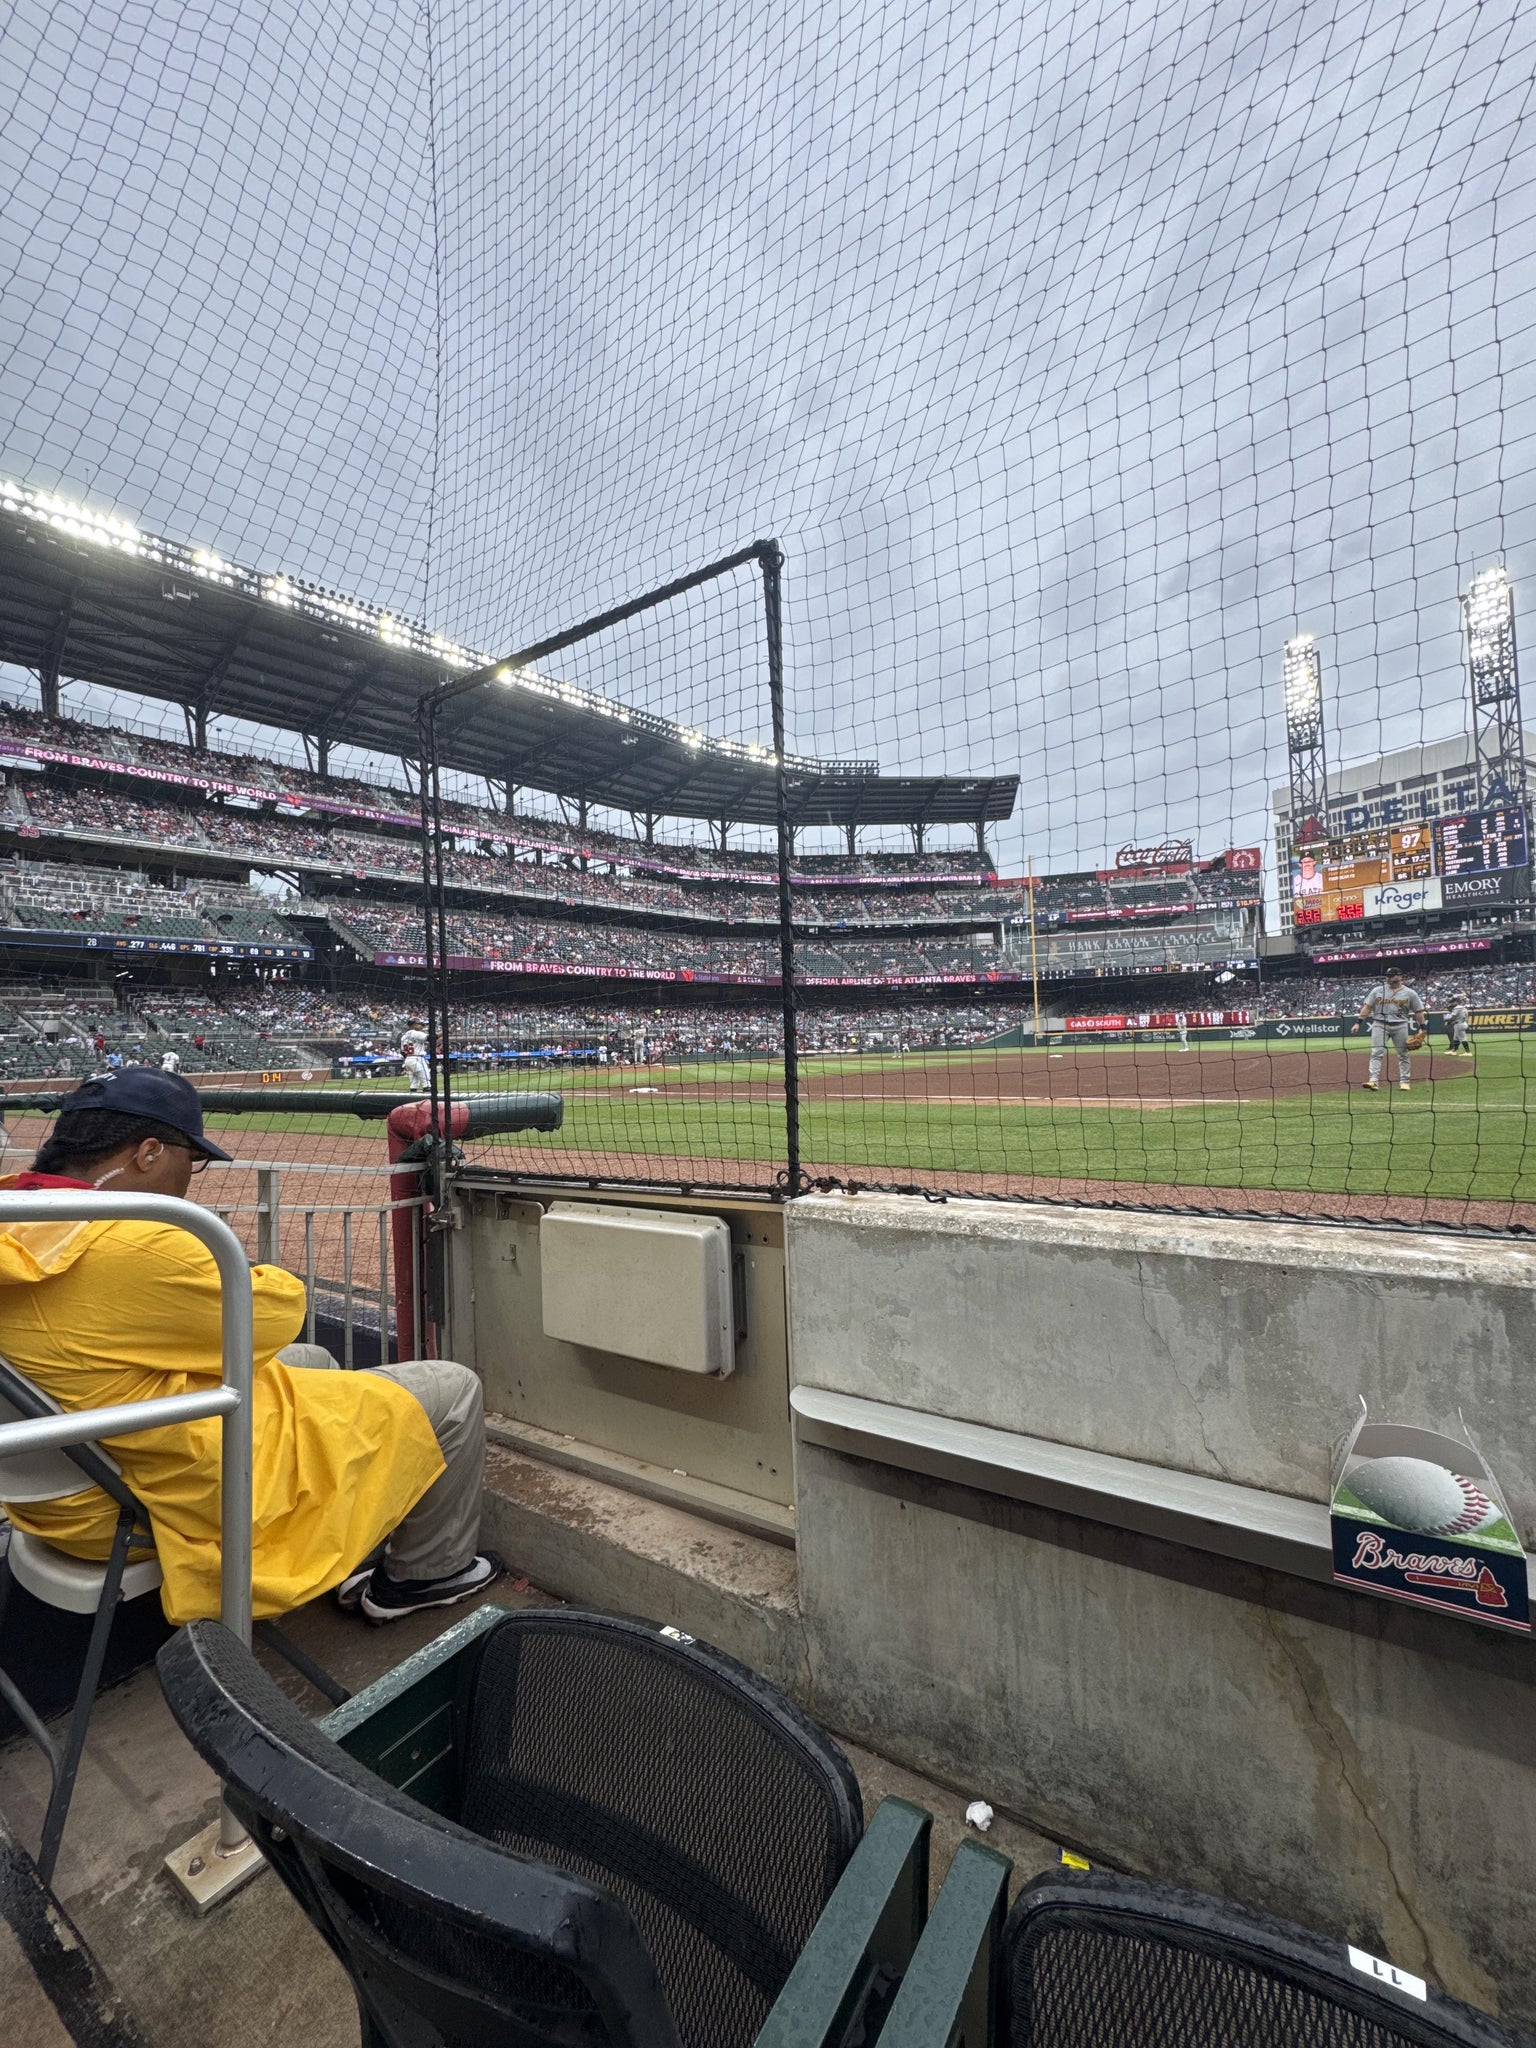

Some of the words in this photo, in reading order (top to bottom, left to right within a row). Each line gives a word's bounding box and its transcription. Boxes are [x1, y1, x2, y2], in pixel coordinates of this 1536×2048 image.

[25, 747, 68, 762] FROM
[72, 755, 125, 773] BRAVES
[127, 766, 189, 784] COUNTRY
[192, 778, 209, 788] TO
[211, 781, 233, 792] THE
[236, 786, 276, 800] WORLD
[1343, 778, 1519, 832] DELTA
[360, 810, 385, 819] DELTA
[18, 824, 40, 838] 35
[1401, 832, 1421, 849] 97
[1445, 877, 1502, 894] EMORY
[1375, 887, 1429, 909] Kroger
[1445, 889, 1501, 900] HEALTHCARE
[1069, 940, 1100, 952] HANK
[1106, 937, 1149, 949] AARON
[1153, 933, 1217, 946] TERRACE
[1450, 941, 1484, 950] DELTA
[1328, 953, 1356, 961] DELTA
[490, 961, 523, 972] FROM
[526, 963, 564, 974] BRAVES
[566, 966, 612, 977] COUNTRY
[614, 968, 626, 977] TO
[628, 969, 644, 978] THE
[646, 970, 675, 980] WORLD
[805, 978, 840, 986] OFFICIAL
[904, 976, 942, 984] ATLANTA
[943, 975, 976, 983] BRAVES
[1468, 1013, 1534, 1026] UIKRETE
[1293, 1024, 1340, 1033] Wellstar
[1352, 1531, 1477, 1576] Braves
